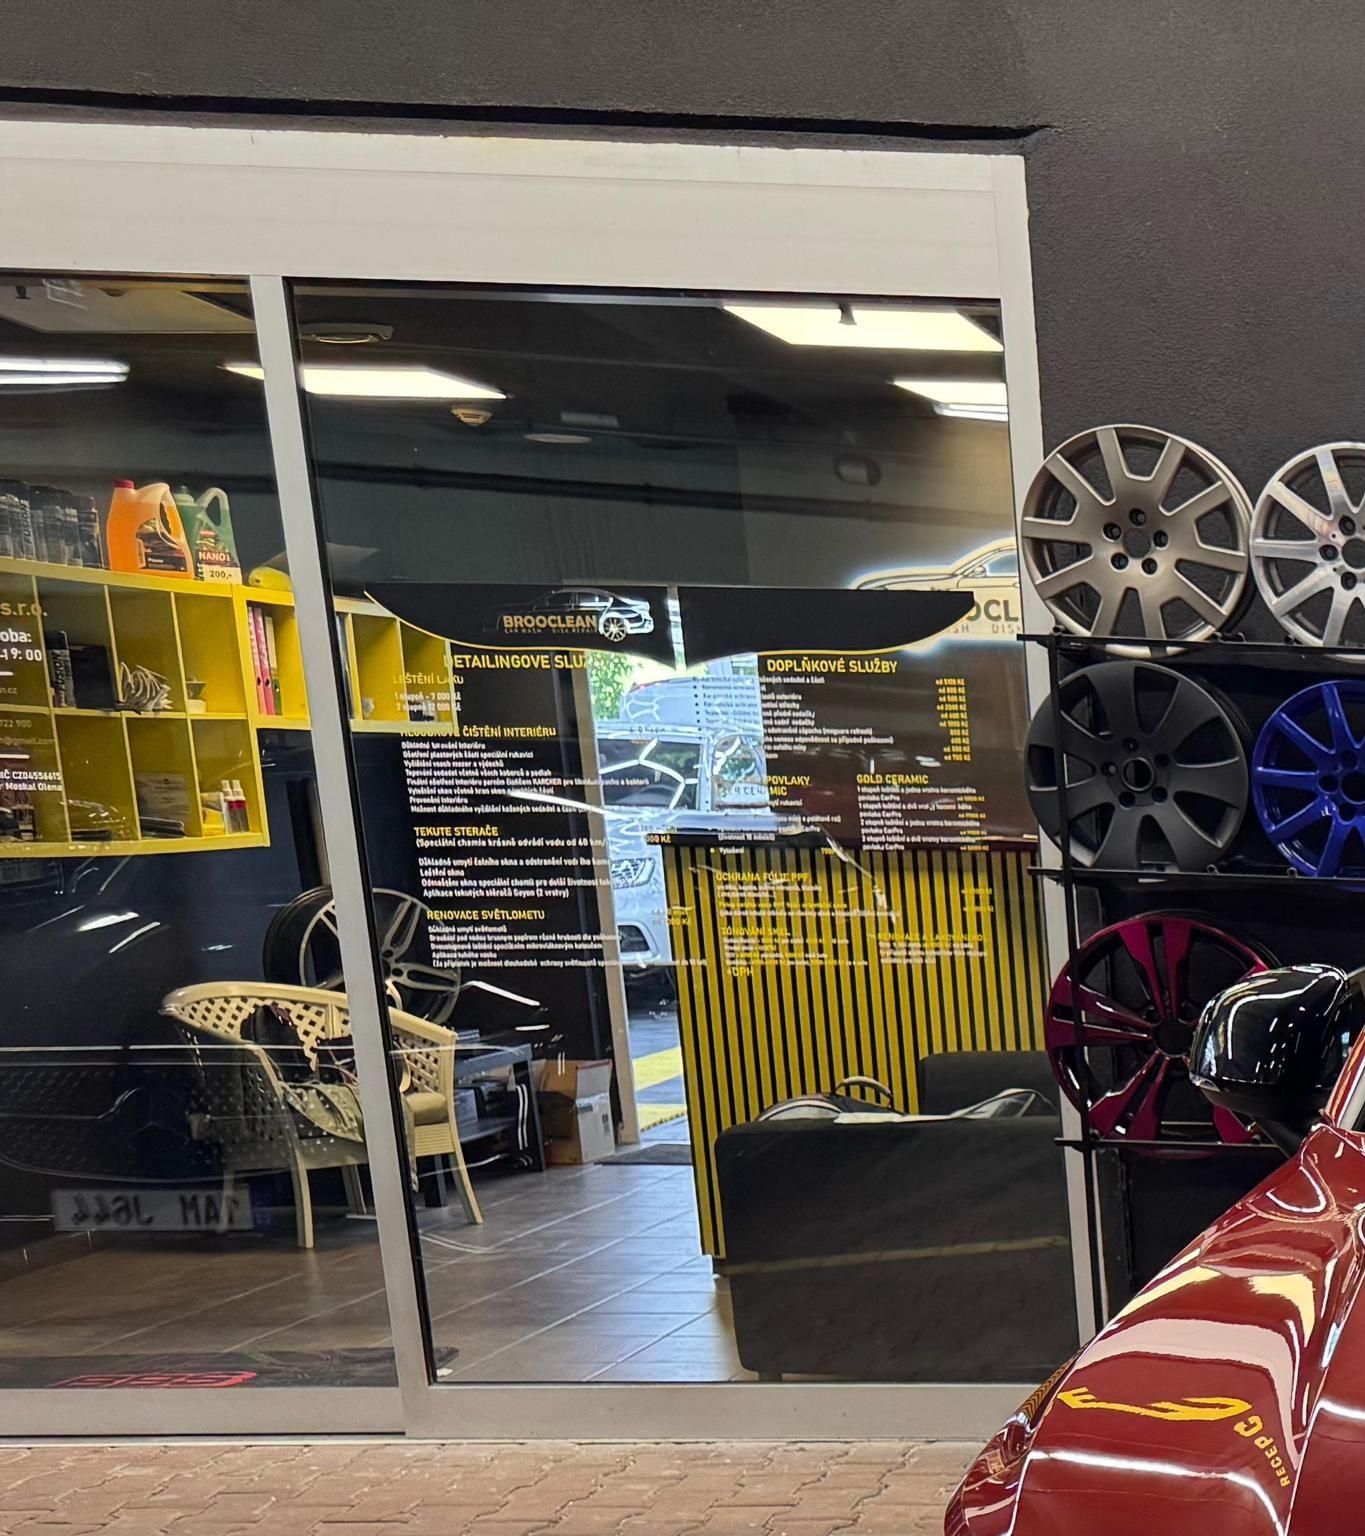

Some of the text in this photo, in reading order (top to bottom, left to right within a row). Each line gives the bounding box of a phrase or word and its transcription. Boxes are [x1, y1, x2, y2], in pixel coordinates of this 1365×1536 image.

[502, 615, 598, 628] BROOCLEAN
[766, 656, 898, 673] DOPLŇKOVÉ SLUŽBY
[462, 725, 501, 737] ČIŠTĚNÍ
[503, 725, 557, 738] INTERIÉRU
[856, 774, 929, 785] GOLD CERAMIC
[413, 825, 499, 837] TEKUTE STERAČE
[426, 908, 546, 920] RENOVACE SVĚTLOMETU
